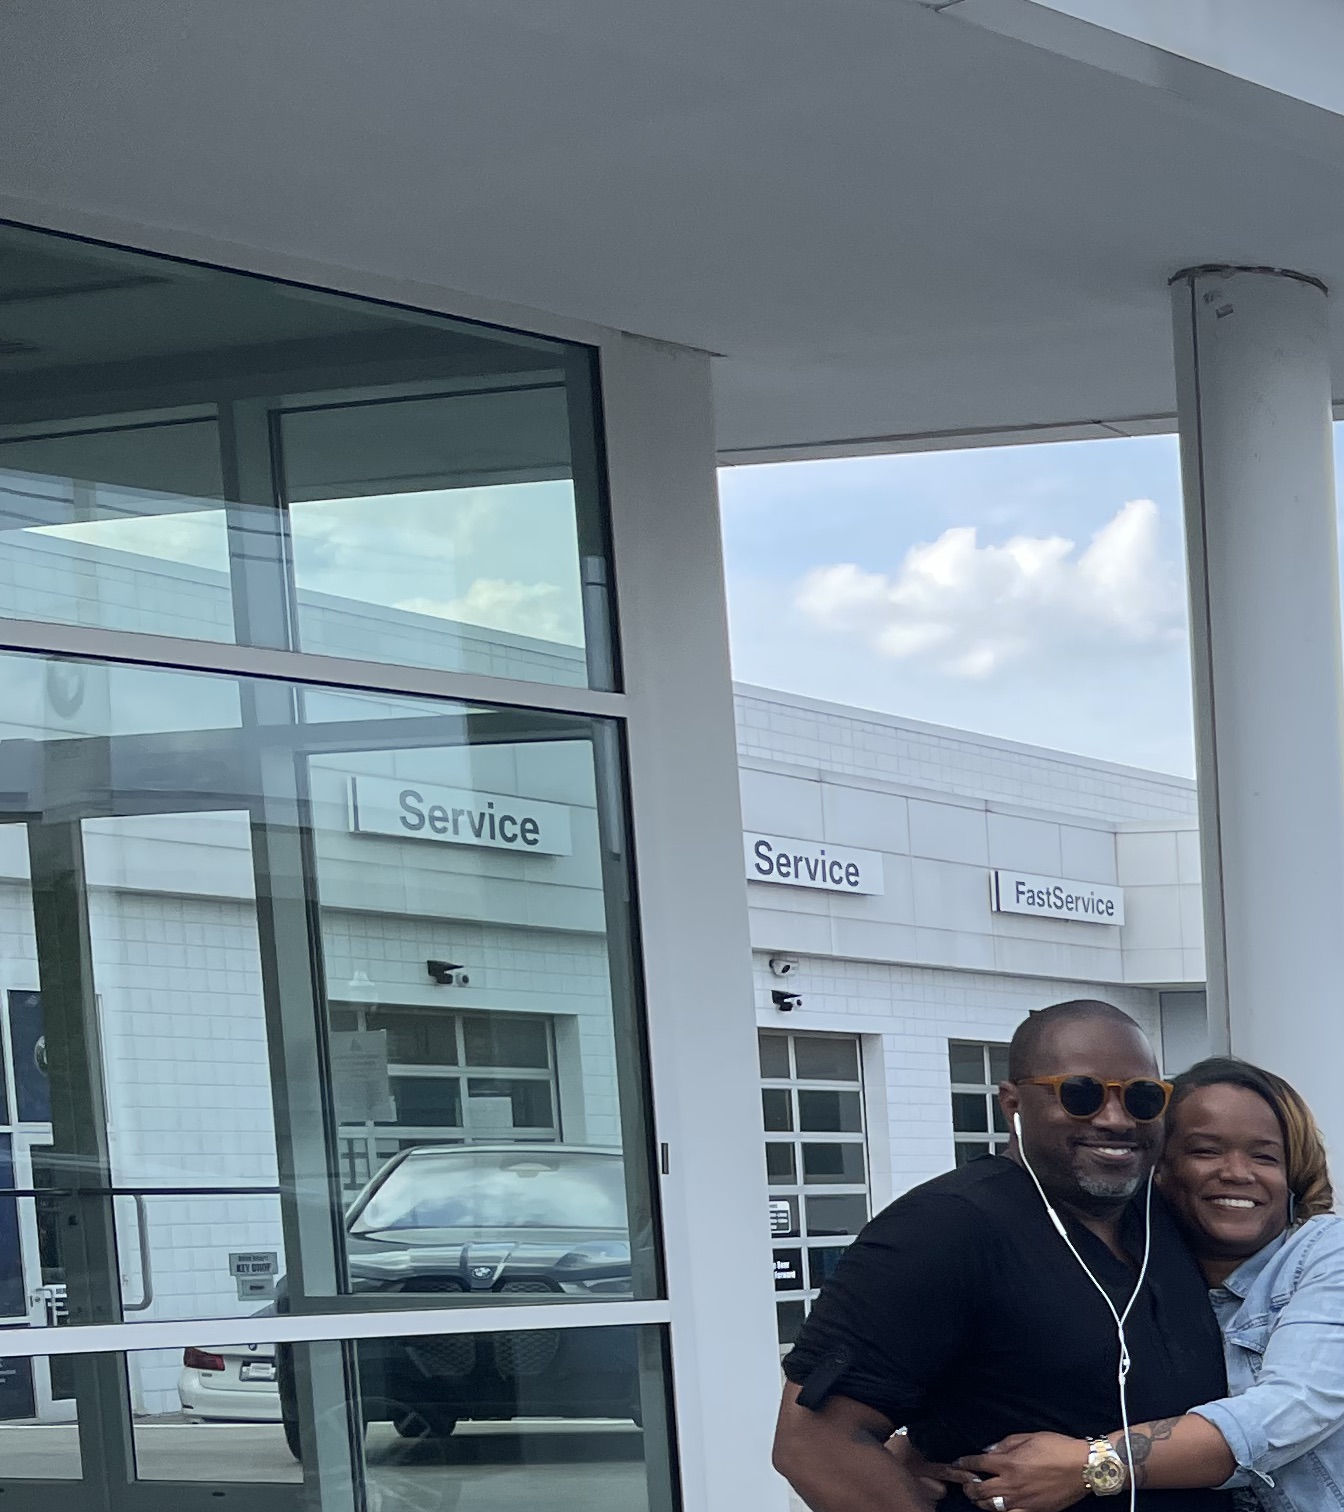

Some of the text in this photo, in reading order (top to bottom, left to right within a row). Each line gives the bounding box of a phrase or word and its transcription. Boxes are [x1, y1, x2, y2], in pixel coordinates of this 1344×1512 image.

[399, 789, 540, 846] Service
[754, 839, 860, 888] Service
[1015, 880, 1115, 917] FastService
